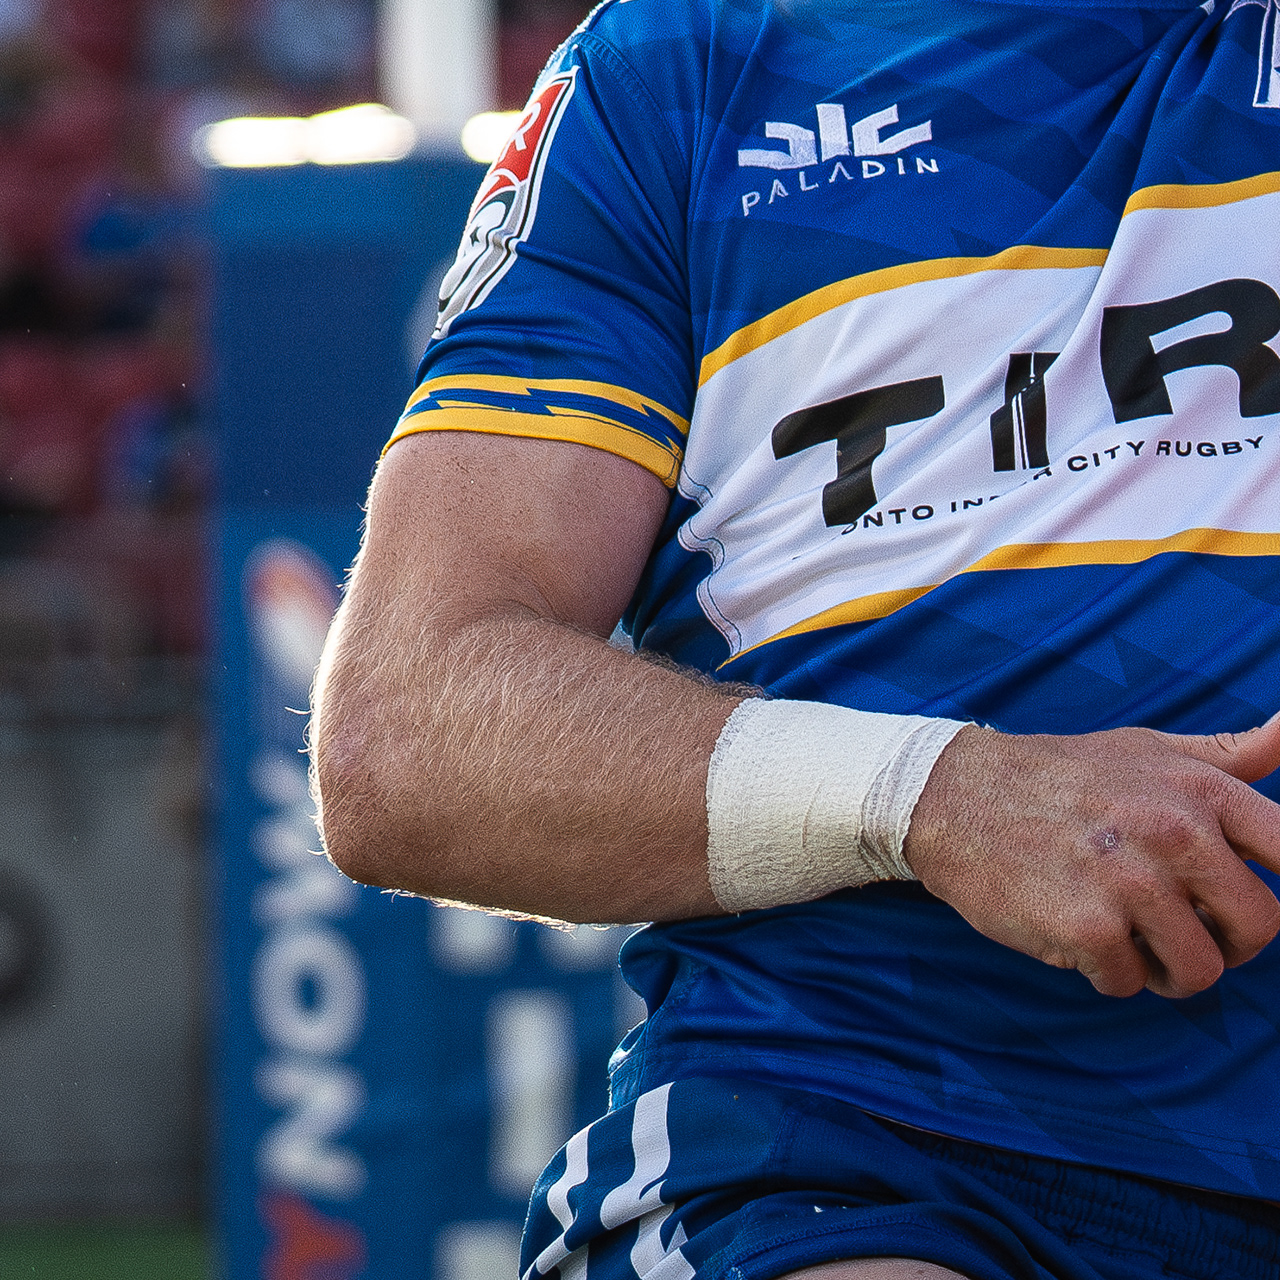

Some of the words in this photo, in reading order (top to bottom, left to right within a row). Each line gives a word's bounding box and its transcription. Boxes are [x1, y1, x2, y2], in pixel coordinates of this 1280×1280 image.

[741, 157, 940, 217] PALADIN
[1067, 440, 1146, 472] CITY
[1155, 435, 1265, 458] RUGBY
